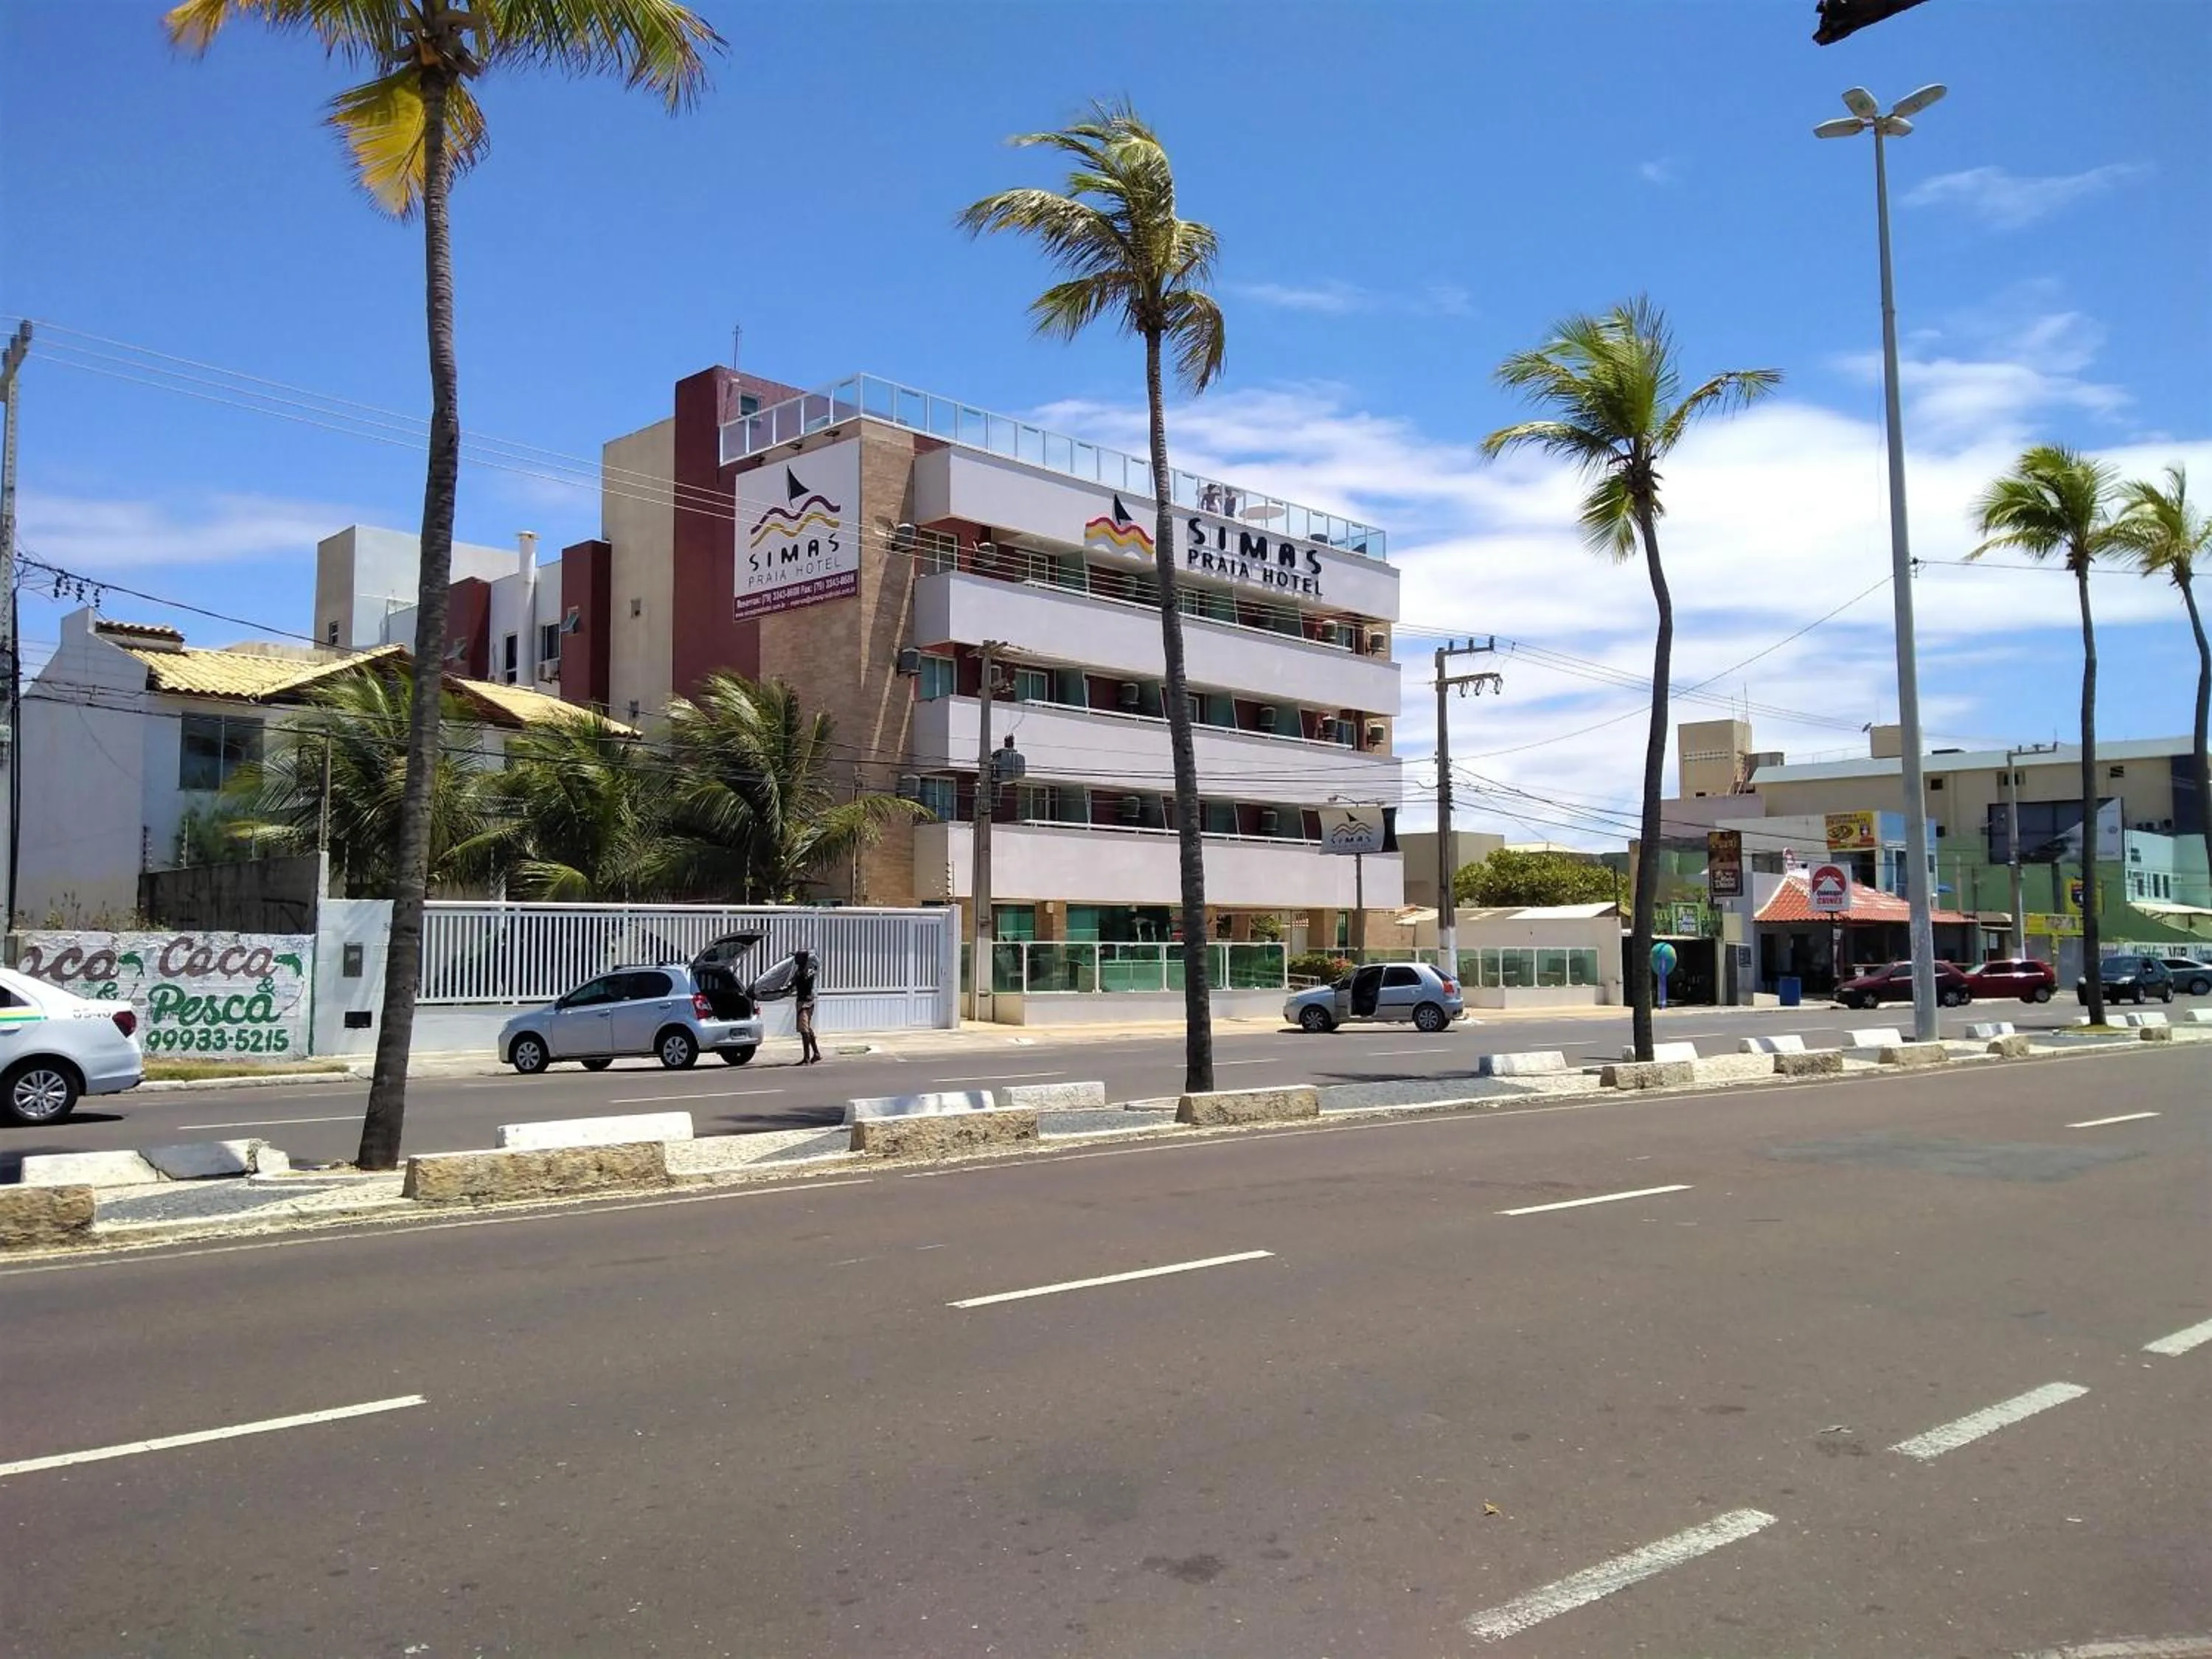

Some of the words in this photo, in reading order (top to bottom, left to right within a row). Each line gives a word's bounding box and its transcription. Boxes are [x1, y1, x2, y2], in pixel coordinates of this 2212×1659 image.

[748, 532, 840, 571] SIMAS
[1188, 517, 1322, 574] SIMAS
[748, 569, 787, 588] PRAIA
[795, 557, 842, 577] HOTEL
[1189, 549, 1249, 579] PRAIA
[1263, 567, 1324, 596] HOTEL
[159, 936, 279, 980] Caça
[147, 984, 282, 1026] Pesca
[146, 1028, 290, 1052] 99933-5215
